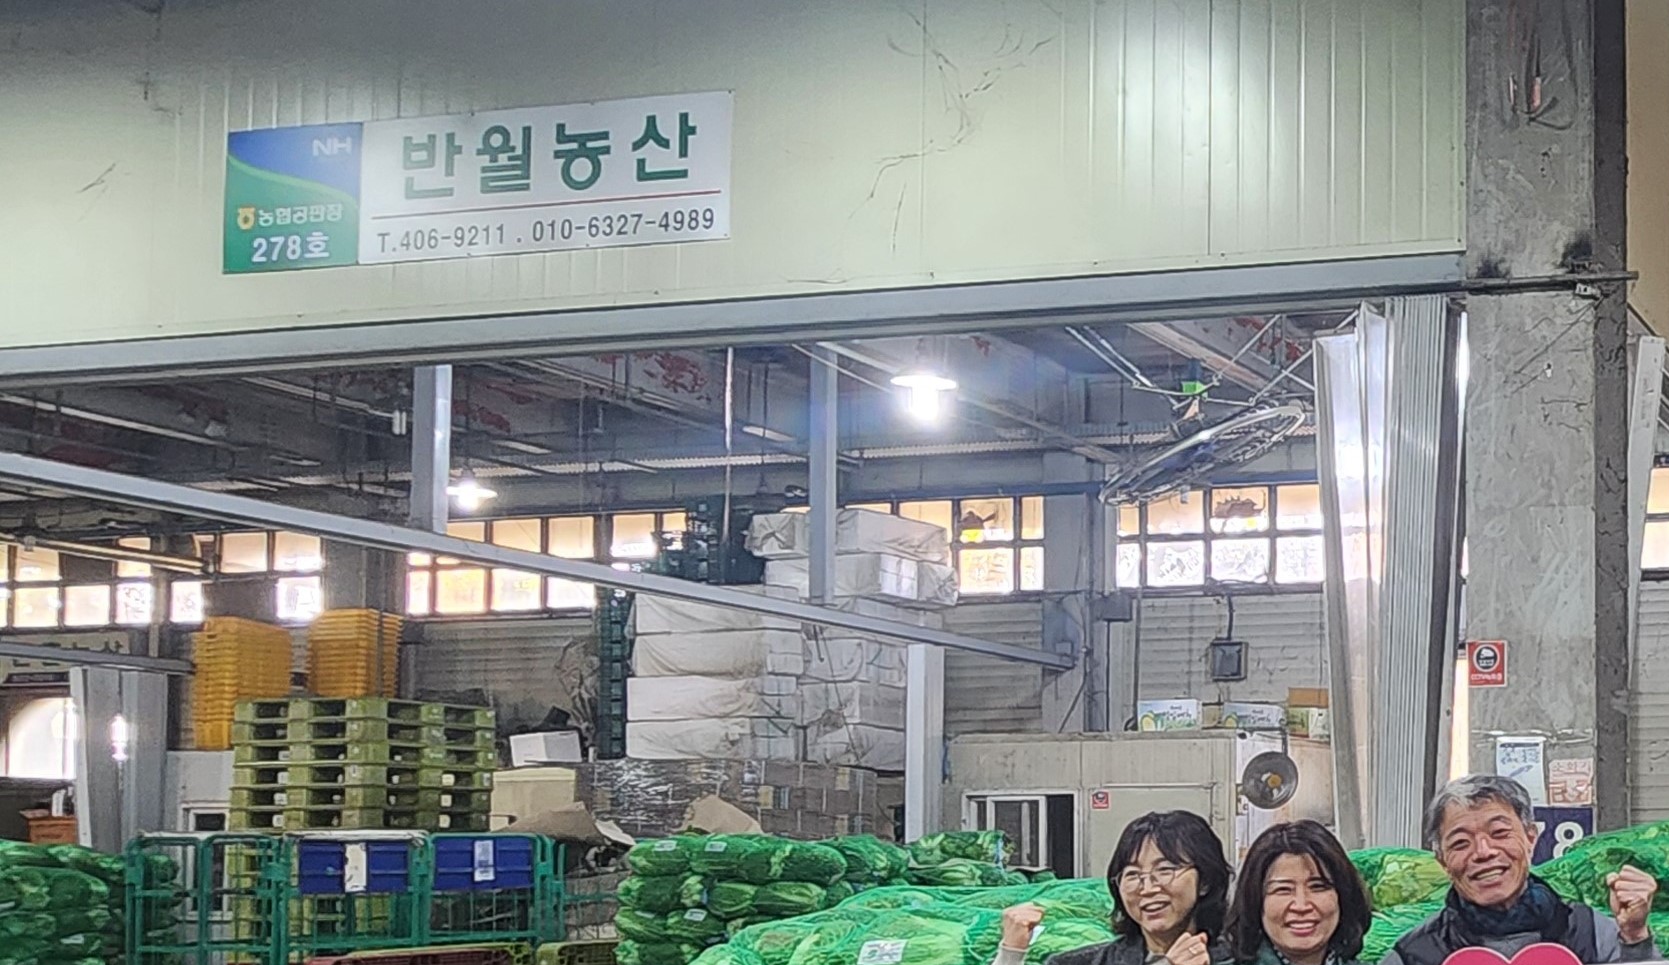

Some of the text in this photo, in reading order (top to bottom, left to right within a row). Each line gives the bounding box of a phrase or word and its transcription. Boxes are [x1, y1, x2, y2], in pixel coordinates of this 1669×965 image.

[312, 137, 352, 156] NH
[402, 111, 697, 200] 반월농산
[258, 203, 342, 227] 농협공판장
[377, 224, 505, 253] T.406-9211
[532, 208, 715, 242] 010-6327-4989
[251, 231, 330, 262] 278호
